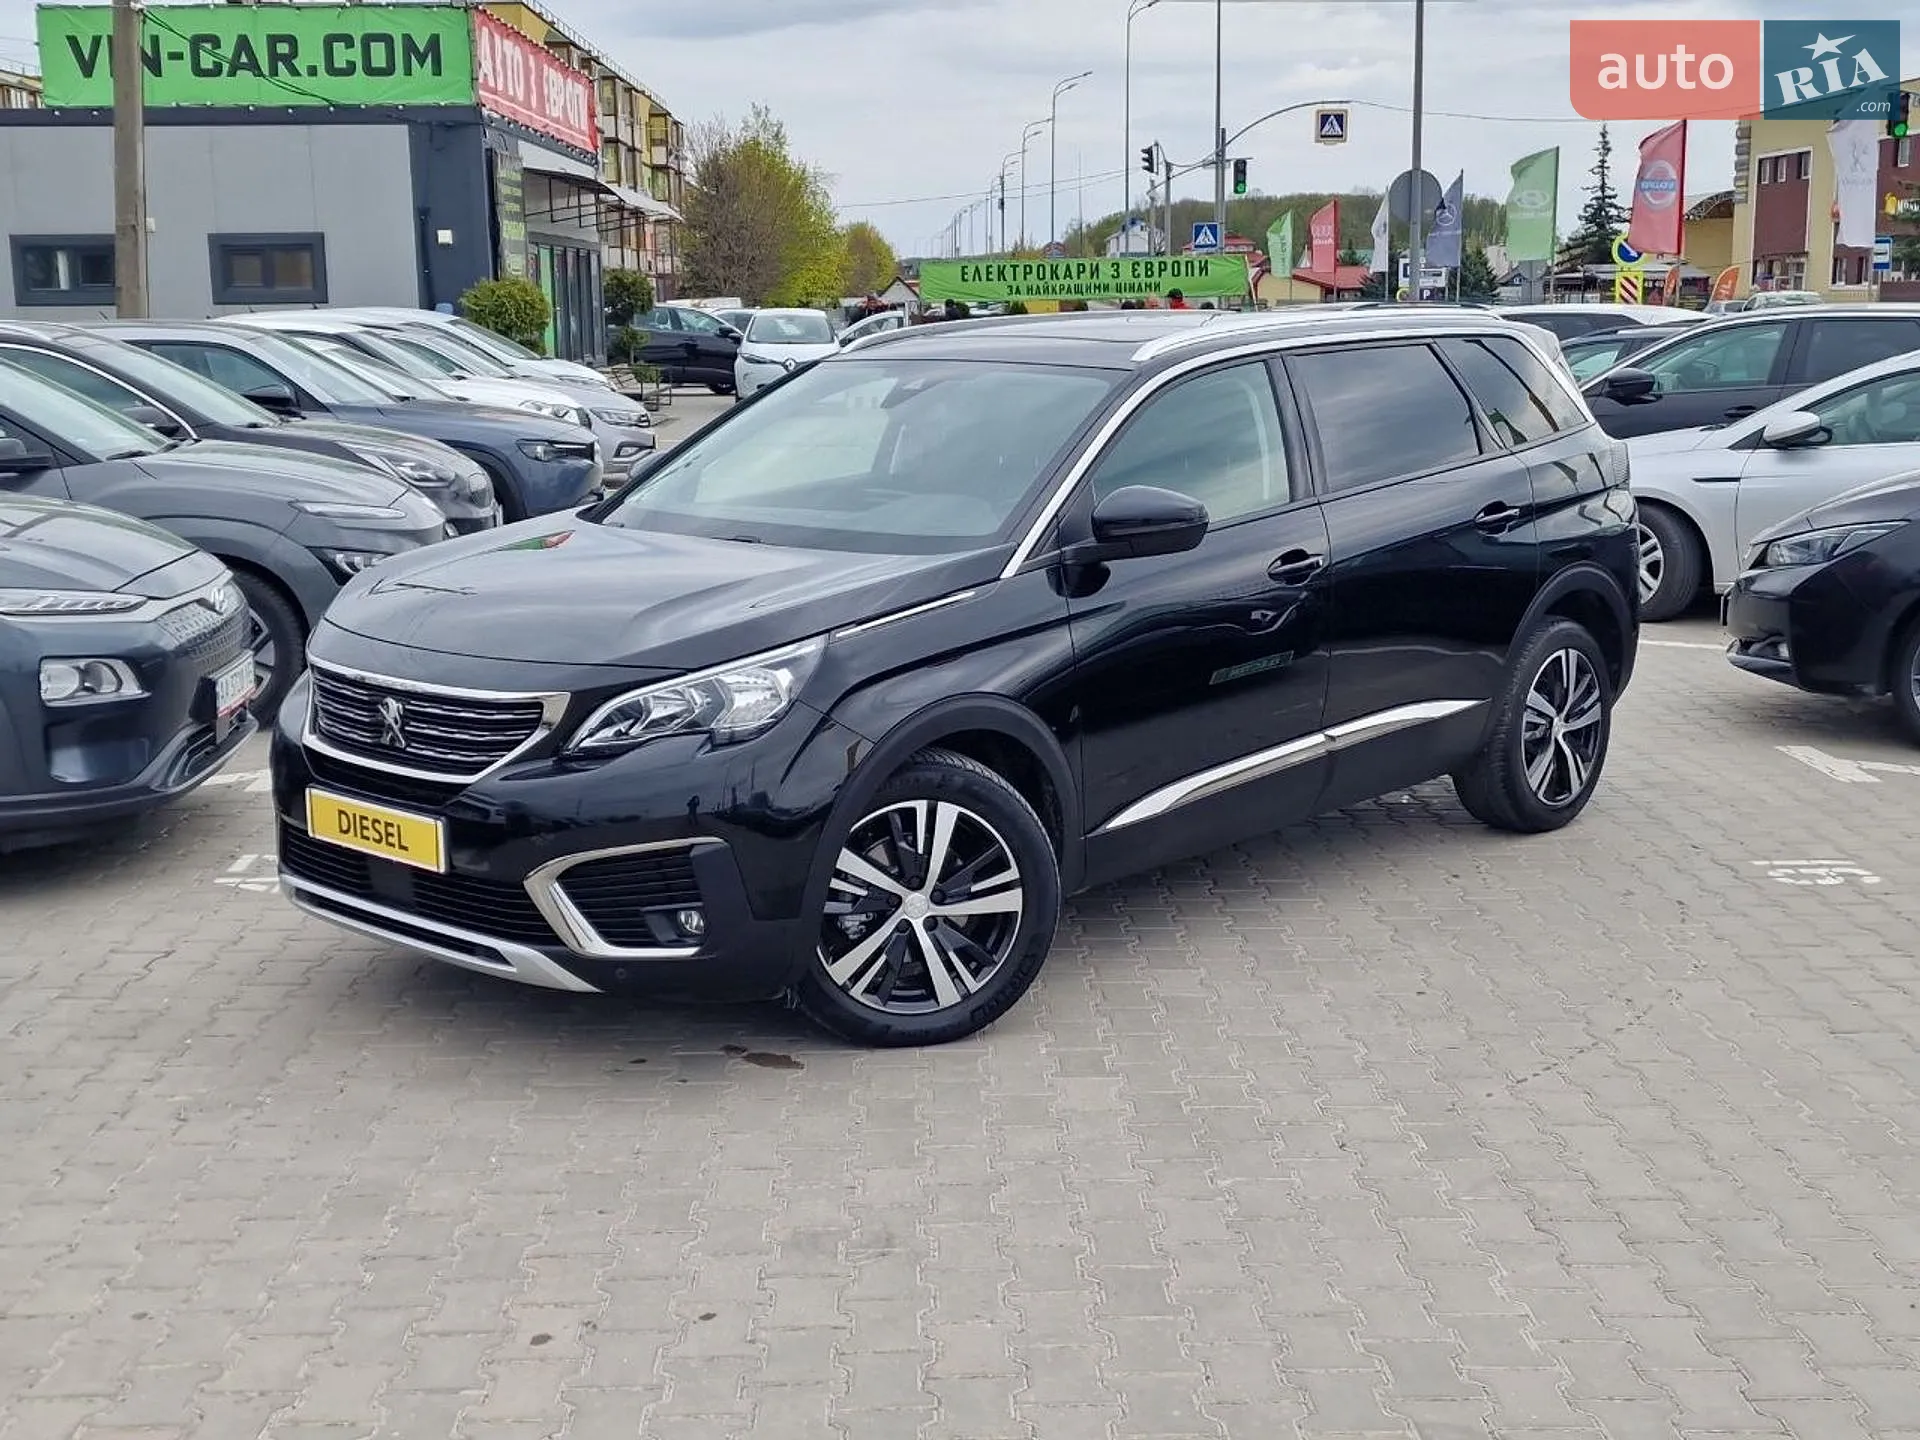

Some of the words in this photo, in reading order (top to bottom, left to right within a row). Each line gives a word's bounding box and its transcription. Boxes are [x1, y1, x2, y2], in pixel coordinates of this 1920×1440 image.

[479, 26, 524, 101] АВТО
[961, 262, 1100, 282] ЕЛЕКТРОКАРИ
[1111, 262, 1120, 279] З
[1131, 259, 1209, 279] ЄВРОПИ
[1007, 284, 1021, 296] ЗА
[1026, 281, 1110, 296] НАЙКРАЩИМИ
[1115, 281, 1161, 294] ЦІНАМИ
[338, 808, 409, 852] DIESEL
